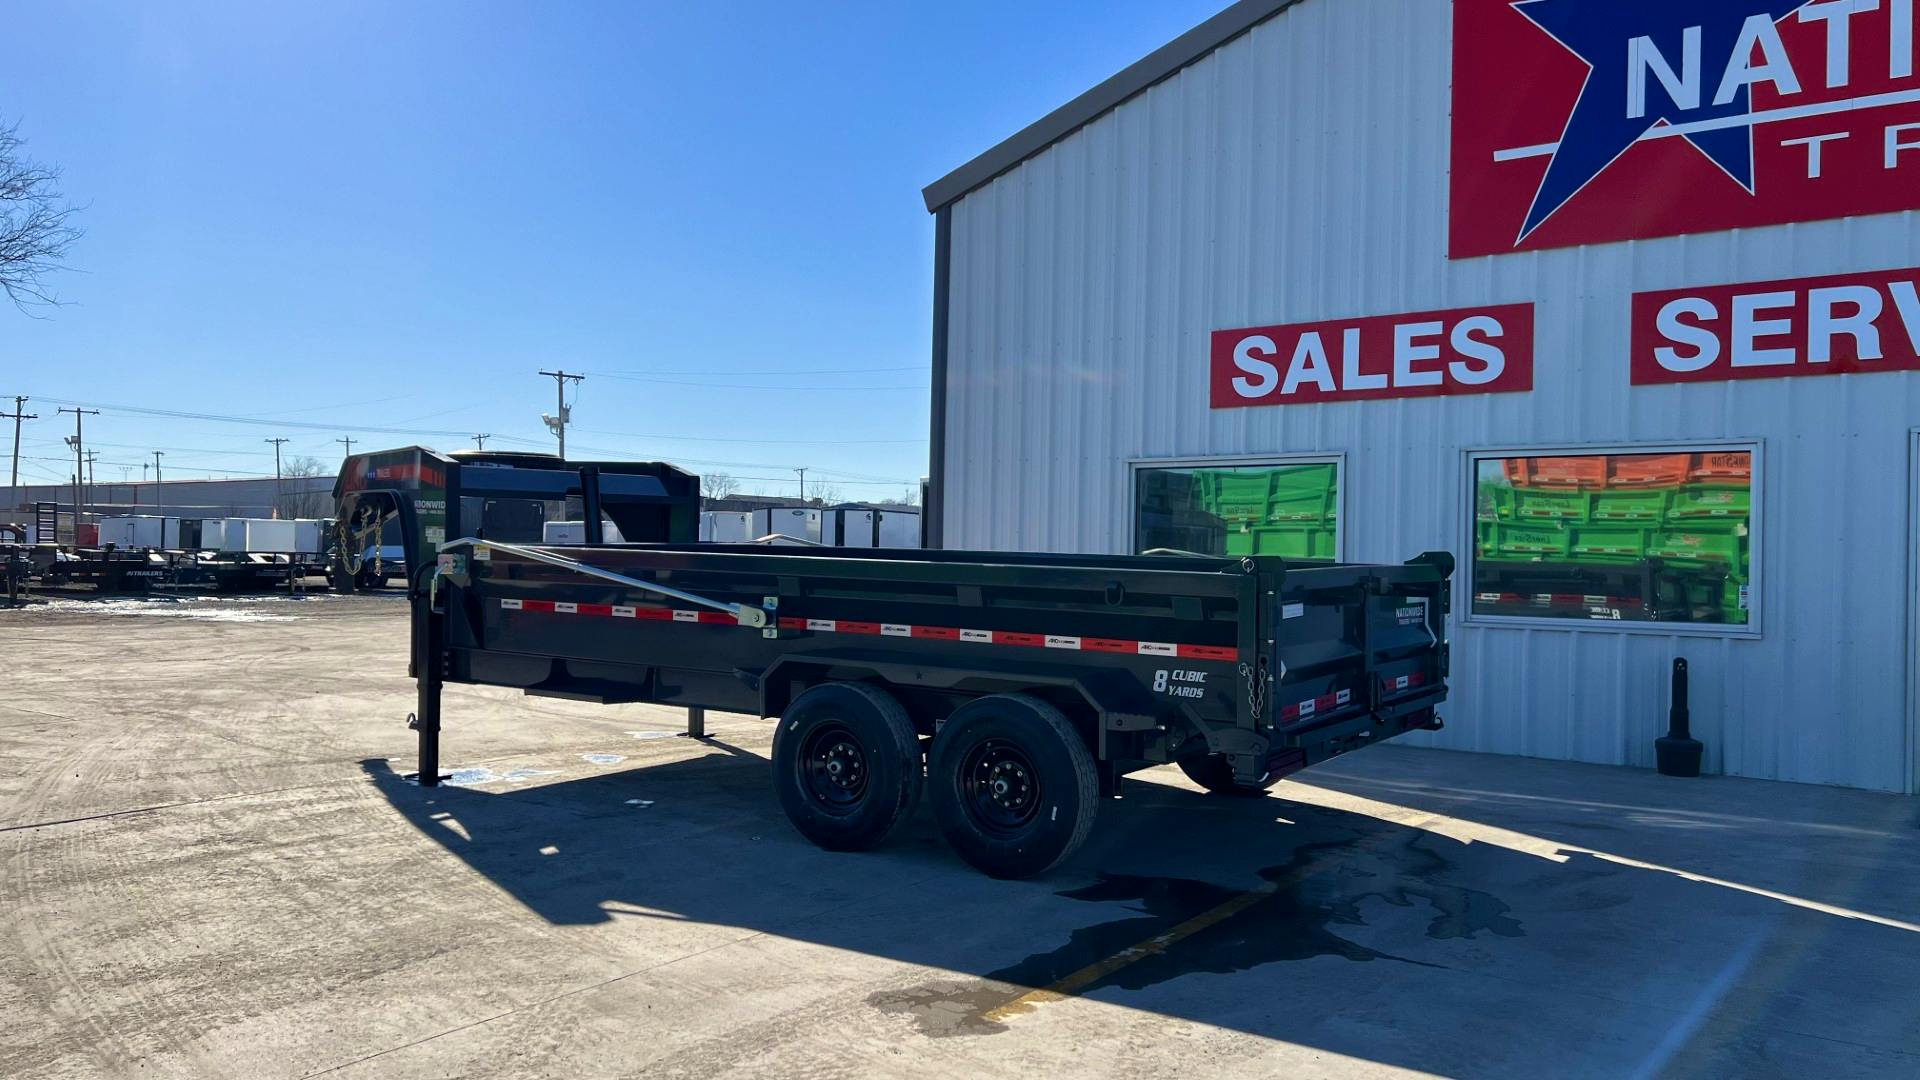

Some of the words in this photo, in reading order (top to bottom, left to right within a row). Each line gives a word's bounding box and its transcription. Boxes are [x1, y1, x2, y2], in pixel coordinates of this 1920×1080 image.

[1231, 315, 1506, 399] SALES
[1152, 669, 1168, 693] 8
[1171, 669, 1209, 683] CUBIC
[1168, 686, 1205, 699] YARDS
